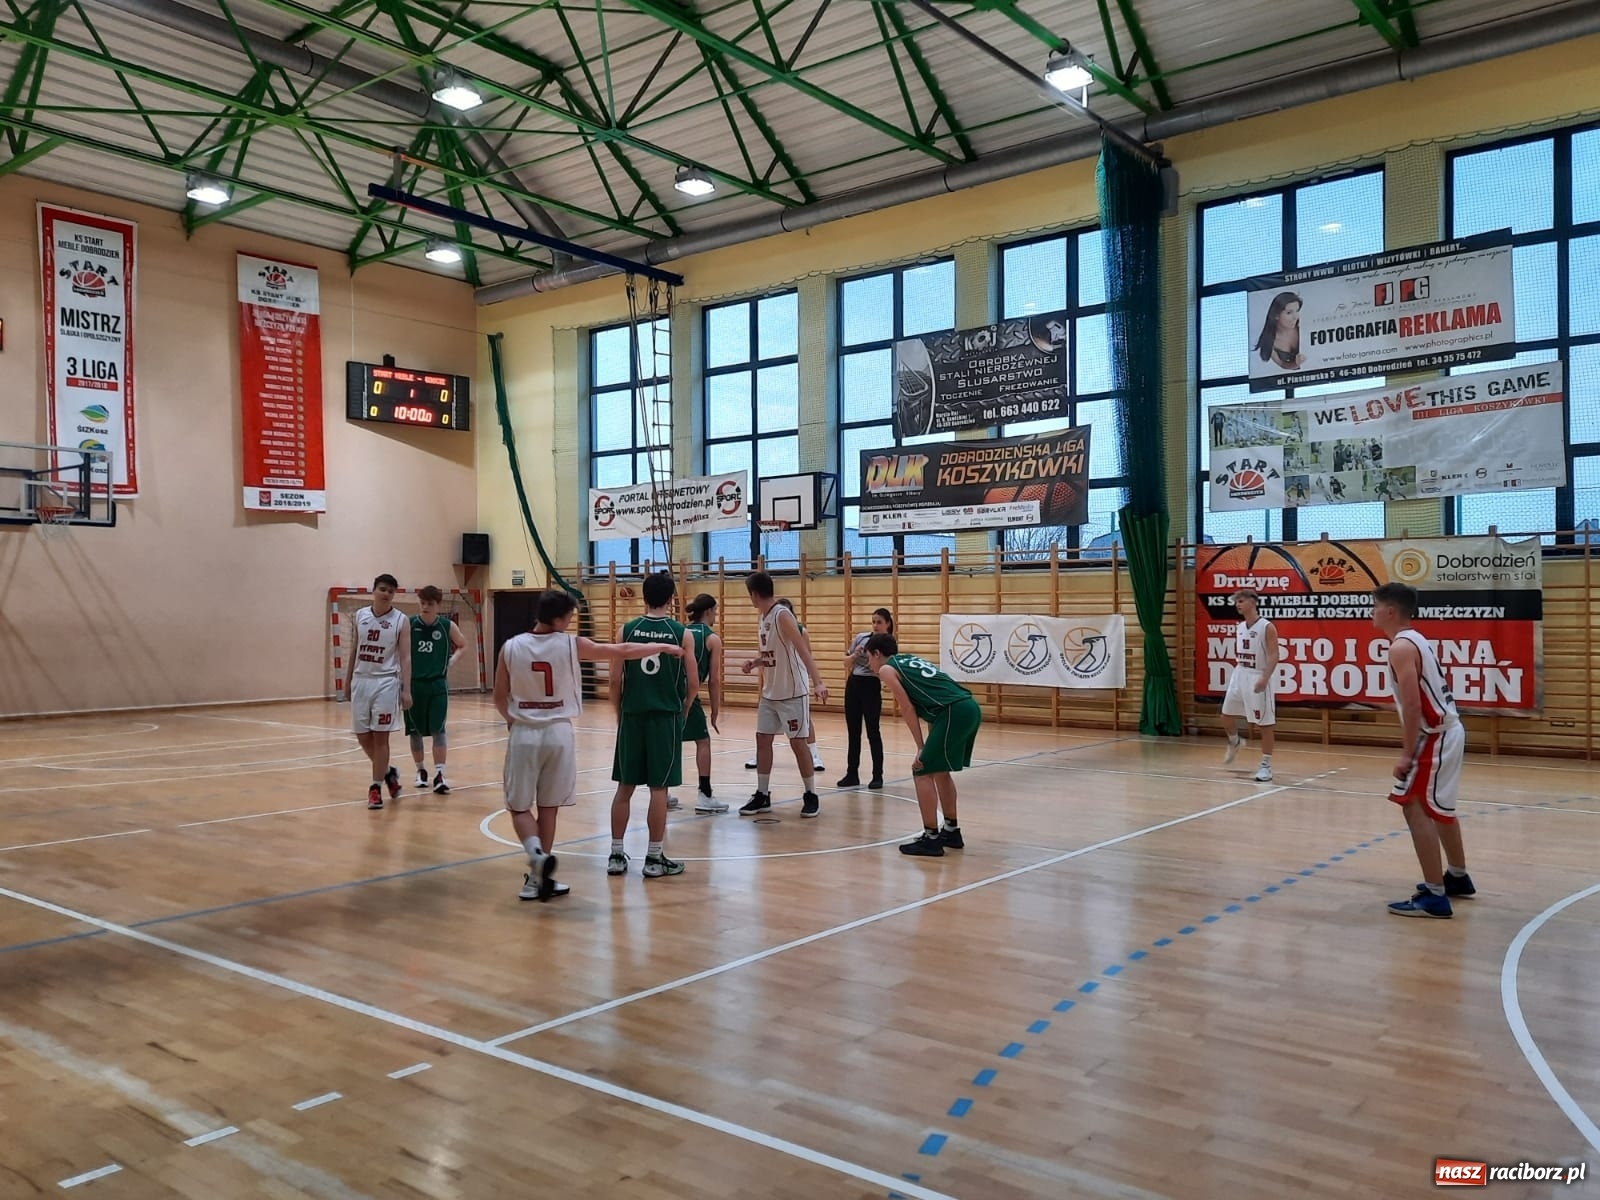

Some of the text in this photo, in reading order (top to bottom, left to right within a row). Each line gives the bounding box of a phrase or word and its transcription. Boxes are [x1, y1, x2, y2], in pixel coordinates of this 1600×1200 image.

[58, 240, 120, 259] MEBLE DOBRODZIEŃ
[75, 234, 103, 246] KS START
[59, 260, 119, 286] START
[258, 266, 294, 283] START
[1284, 271, 1312, 283] STRONY
[1342, 260, 1368, 272] ULOTKI
[1376, 250, 1421, 266] WIZYTÓWKI
[60, 306, 122, 335] MISTRZ
[1310, 302, 1502, 346] FOTOGRAFIA REKLAMA
[1405, 330, 1493, 352] www.photographics.pl
[66, 356, 118, 380] 3 LIGA
[939, 355, 1057, 381] STALI NIERDZEWNEJ
[968, 352, 1025, 369] OBRÓBKA
[1287, 371, 1329, 384] Piastowska
[1329, 370, 1335, 378] 5
[1368, 360, 1413, 374] Dobrodzień
[1431, 356, 1442, 365] 34
[1443, 354, 1455, 363] 35
[1456, 352, 1466, 361] 75
[1467, 350, 1481, 359] 472
[373, 381, 448, 402] 0 1 0
[941, 377, 1059, 401] TOCZENIE FREZOWANIE
[1314, 371, 1552, 426] WE LOVE THIS GAME
[370, 406, 378, 417] 0
[442, 414, 449, 424] 0
[983, 408, 997, 420] tel.
[1000, 404, 1019, 418] 663
[1021, 401, 1039, 415] 440
[1042, 398, 1060, 412] 622
[1439, 407, 1464, 417] LIGA
[1474, 395, 1549, 414] KOSZYKÓWKI
[940, 439, 1085, 465] DOBRODZIEŃSKA LIGA
[936, 454, 1085, 487] KOSZYKÓWKI
[1215, 458, 1281, 486] START
[619, 492, 649, 503] PORTAL
[1310, 557, 1356, 575] START
[1437, 551, 1535, 569] Dobrodzień
[1213, 573, 1290, 591] Drużynę
[1437, 570, 1536, 582] stolarstwem stoi
[1208, 596, 1225, 606] KS
[1275, 595, 1319, 606] MEBLE
[1274, 607, 1314, 618] LIDZE
[1418, 604, 1505, 620] MĘŻCZYZN
[367, 628, 380, 641] 20
[417, 640, 433, 653] 23
[1207, 637, 1334, 662] MSTO
[1344, 638, 1357, 662] I
[531, 661, 553, 696] 7
[1208, 661, 1523, 703] DBRODEŃ
[378, 713, 391, 725] 20
[787, 719, 798, 732] 15
